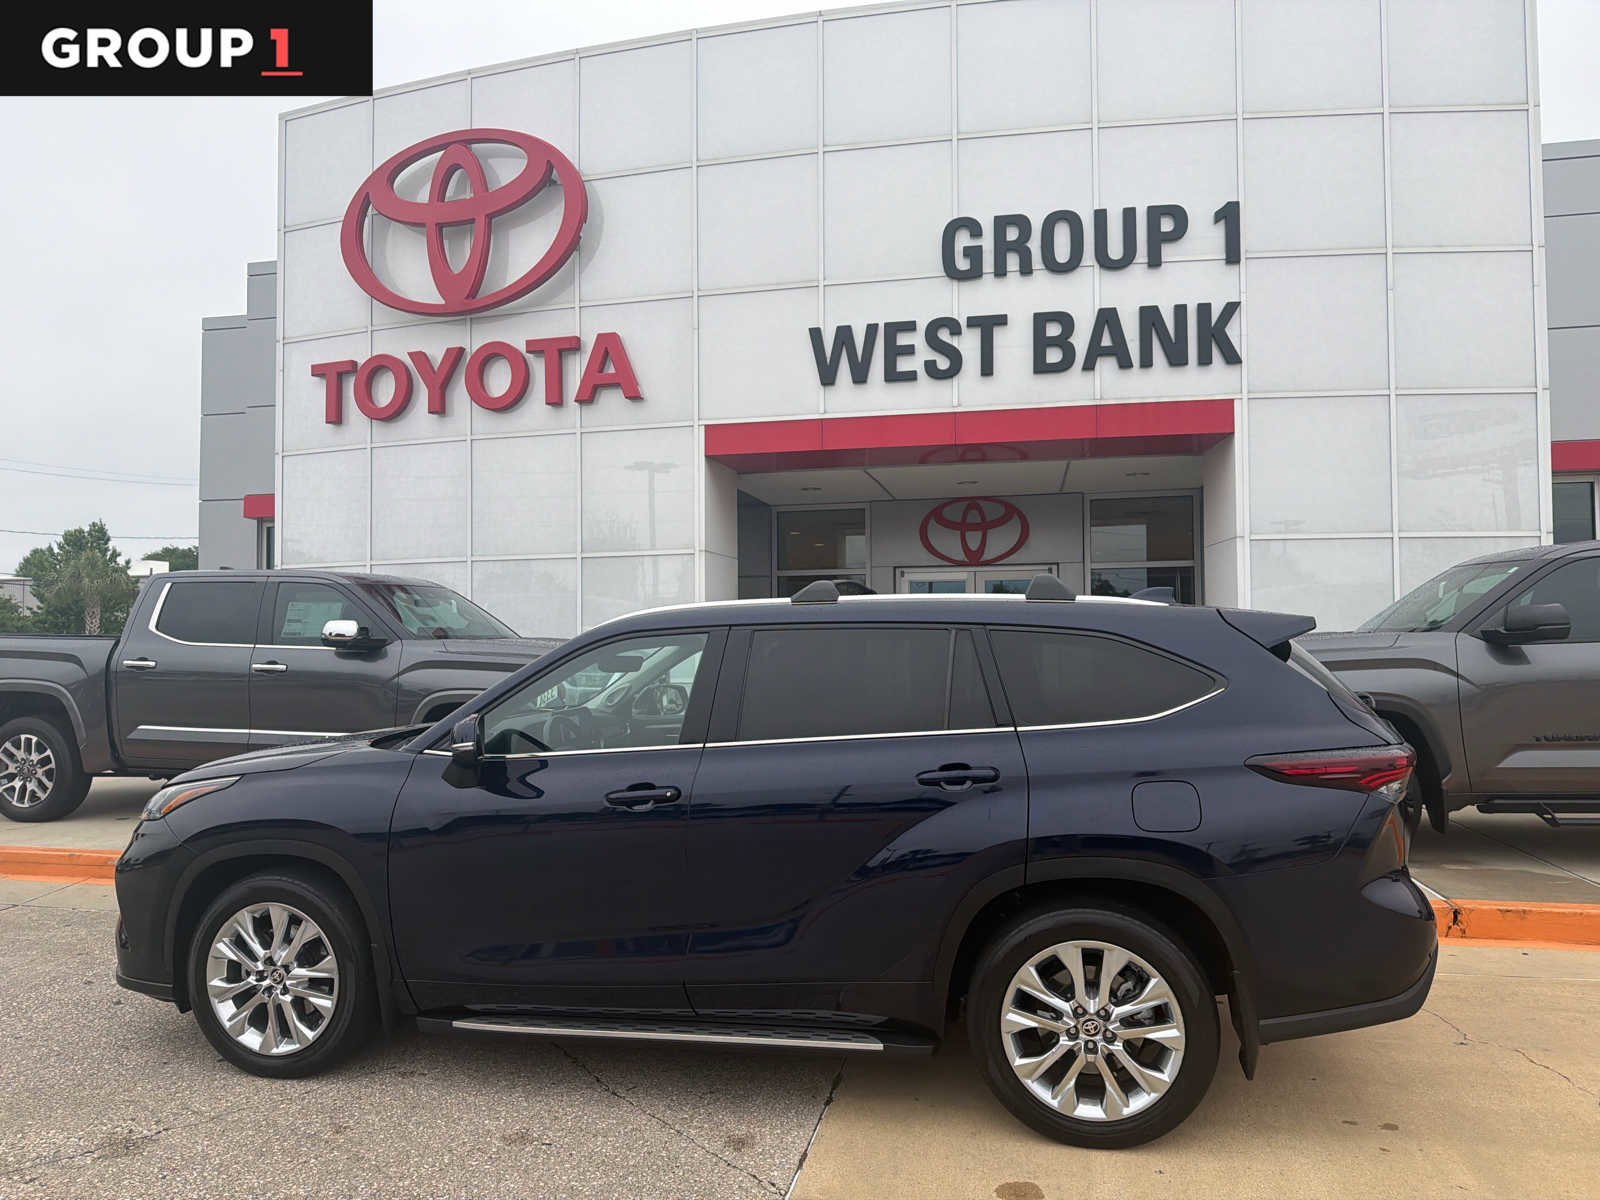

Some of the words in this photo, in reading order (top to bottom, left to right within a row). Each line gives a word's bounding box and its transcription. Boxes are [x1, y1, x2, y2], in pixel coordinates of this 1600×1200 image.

[942, 203, 1189, 280] GROUP
[1213, 201, 1241, 265] 1
[311, 332, 643, 424] TOYOTA
[808, 314, 1008, 386] WEST
[1033, 301, 1242, 374] BANK
